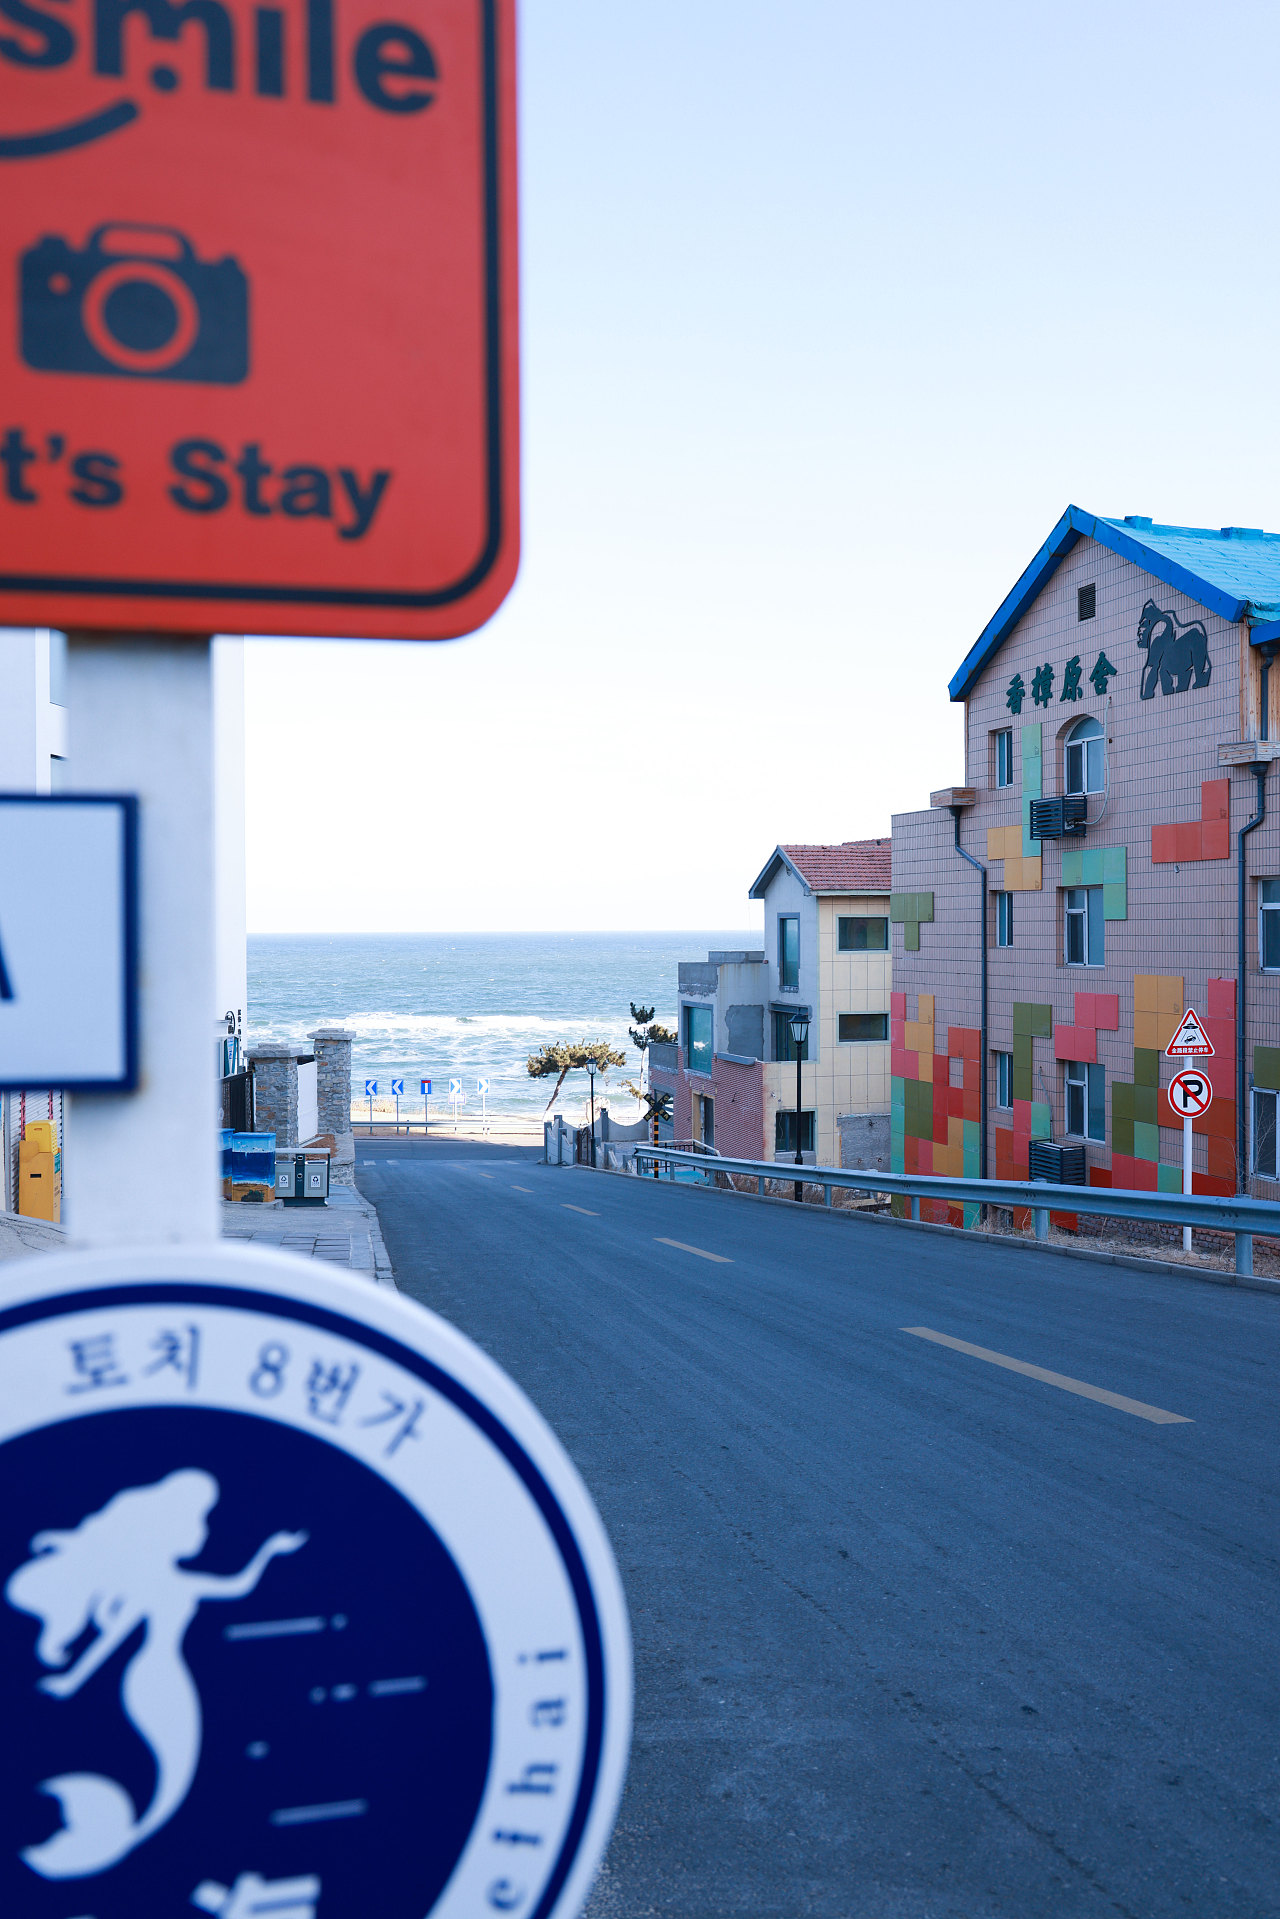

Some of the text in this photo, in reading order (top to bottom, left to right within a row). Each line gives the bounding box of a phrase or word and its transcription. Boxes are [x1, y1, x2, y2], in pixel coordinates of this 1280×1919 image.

[167, 436, 391, 542] Stay
[1006, 651, 1118, 714] 香樟原舍
[63, 1323, 424, 1458] 토치 8번가
